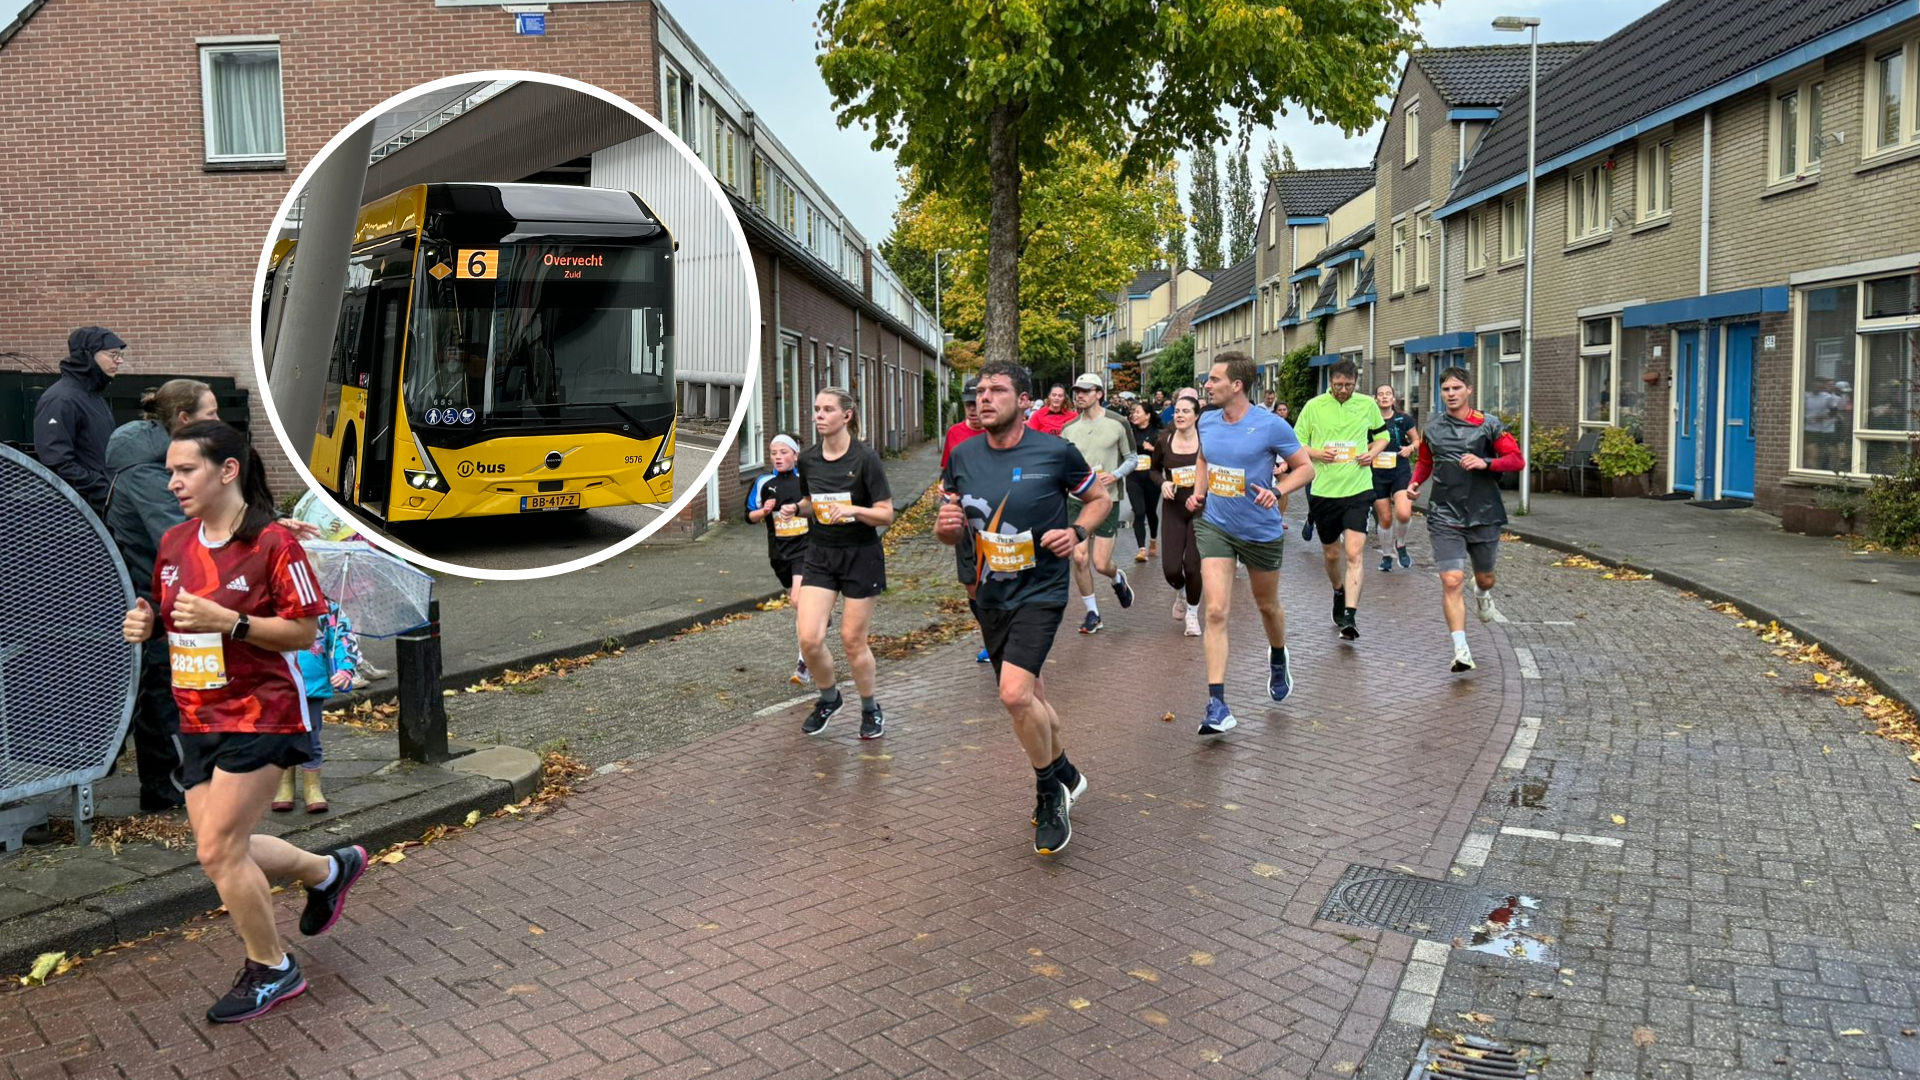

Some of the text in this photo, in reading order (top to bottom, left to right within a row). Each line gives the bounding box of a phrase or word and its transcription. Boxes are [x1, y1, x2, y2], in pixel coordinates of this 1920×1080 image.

[467, 250, 487, 278] 6
[543, 253, 603, 267] Overvecht
[564, 270, 582, 279] Zuid
[624, 455, 643, 464] 9576
[476, 461, 506, 474] bus
[532, 495, 575, 507] BB-417-Z
[996, 545, 1016, 554] TIM
[990, 554, 1025, 565] 23383
[172, 653, 220, 673] 28216
